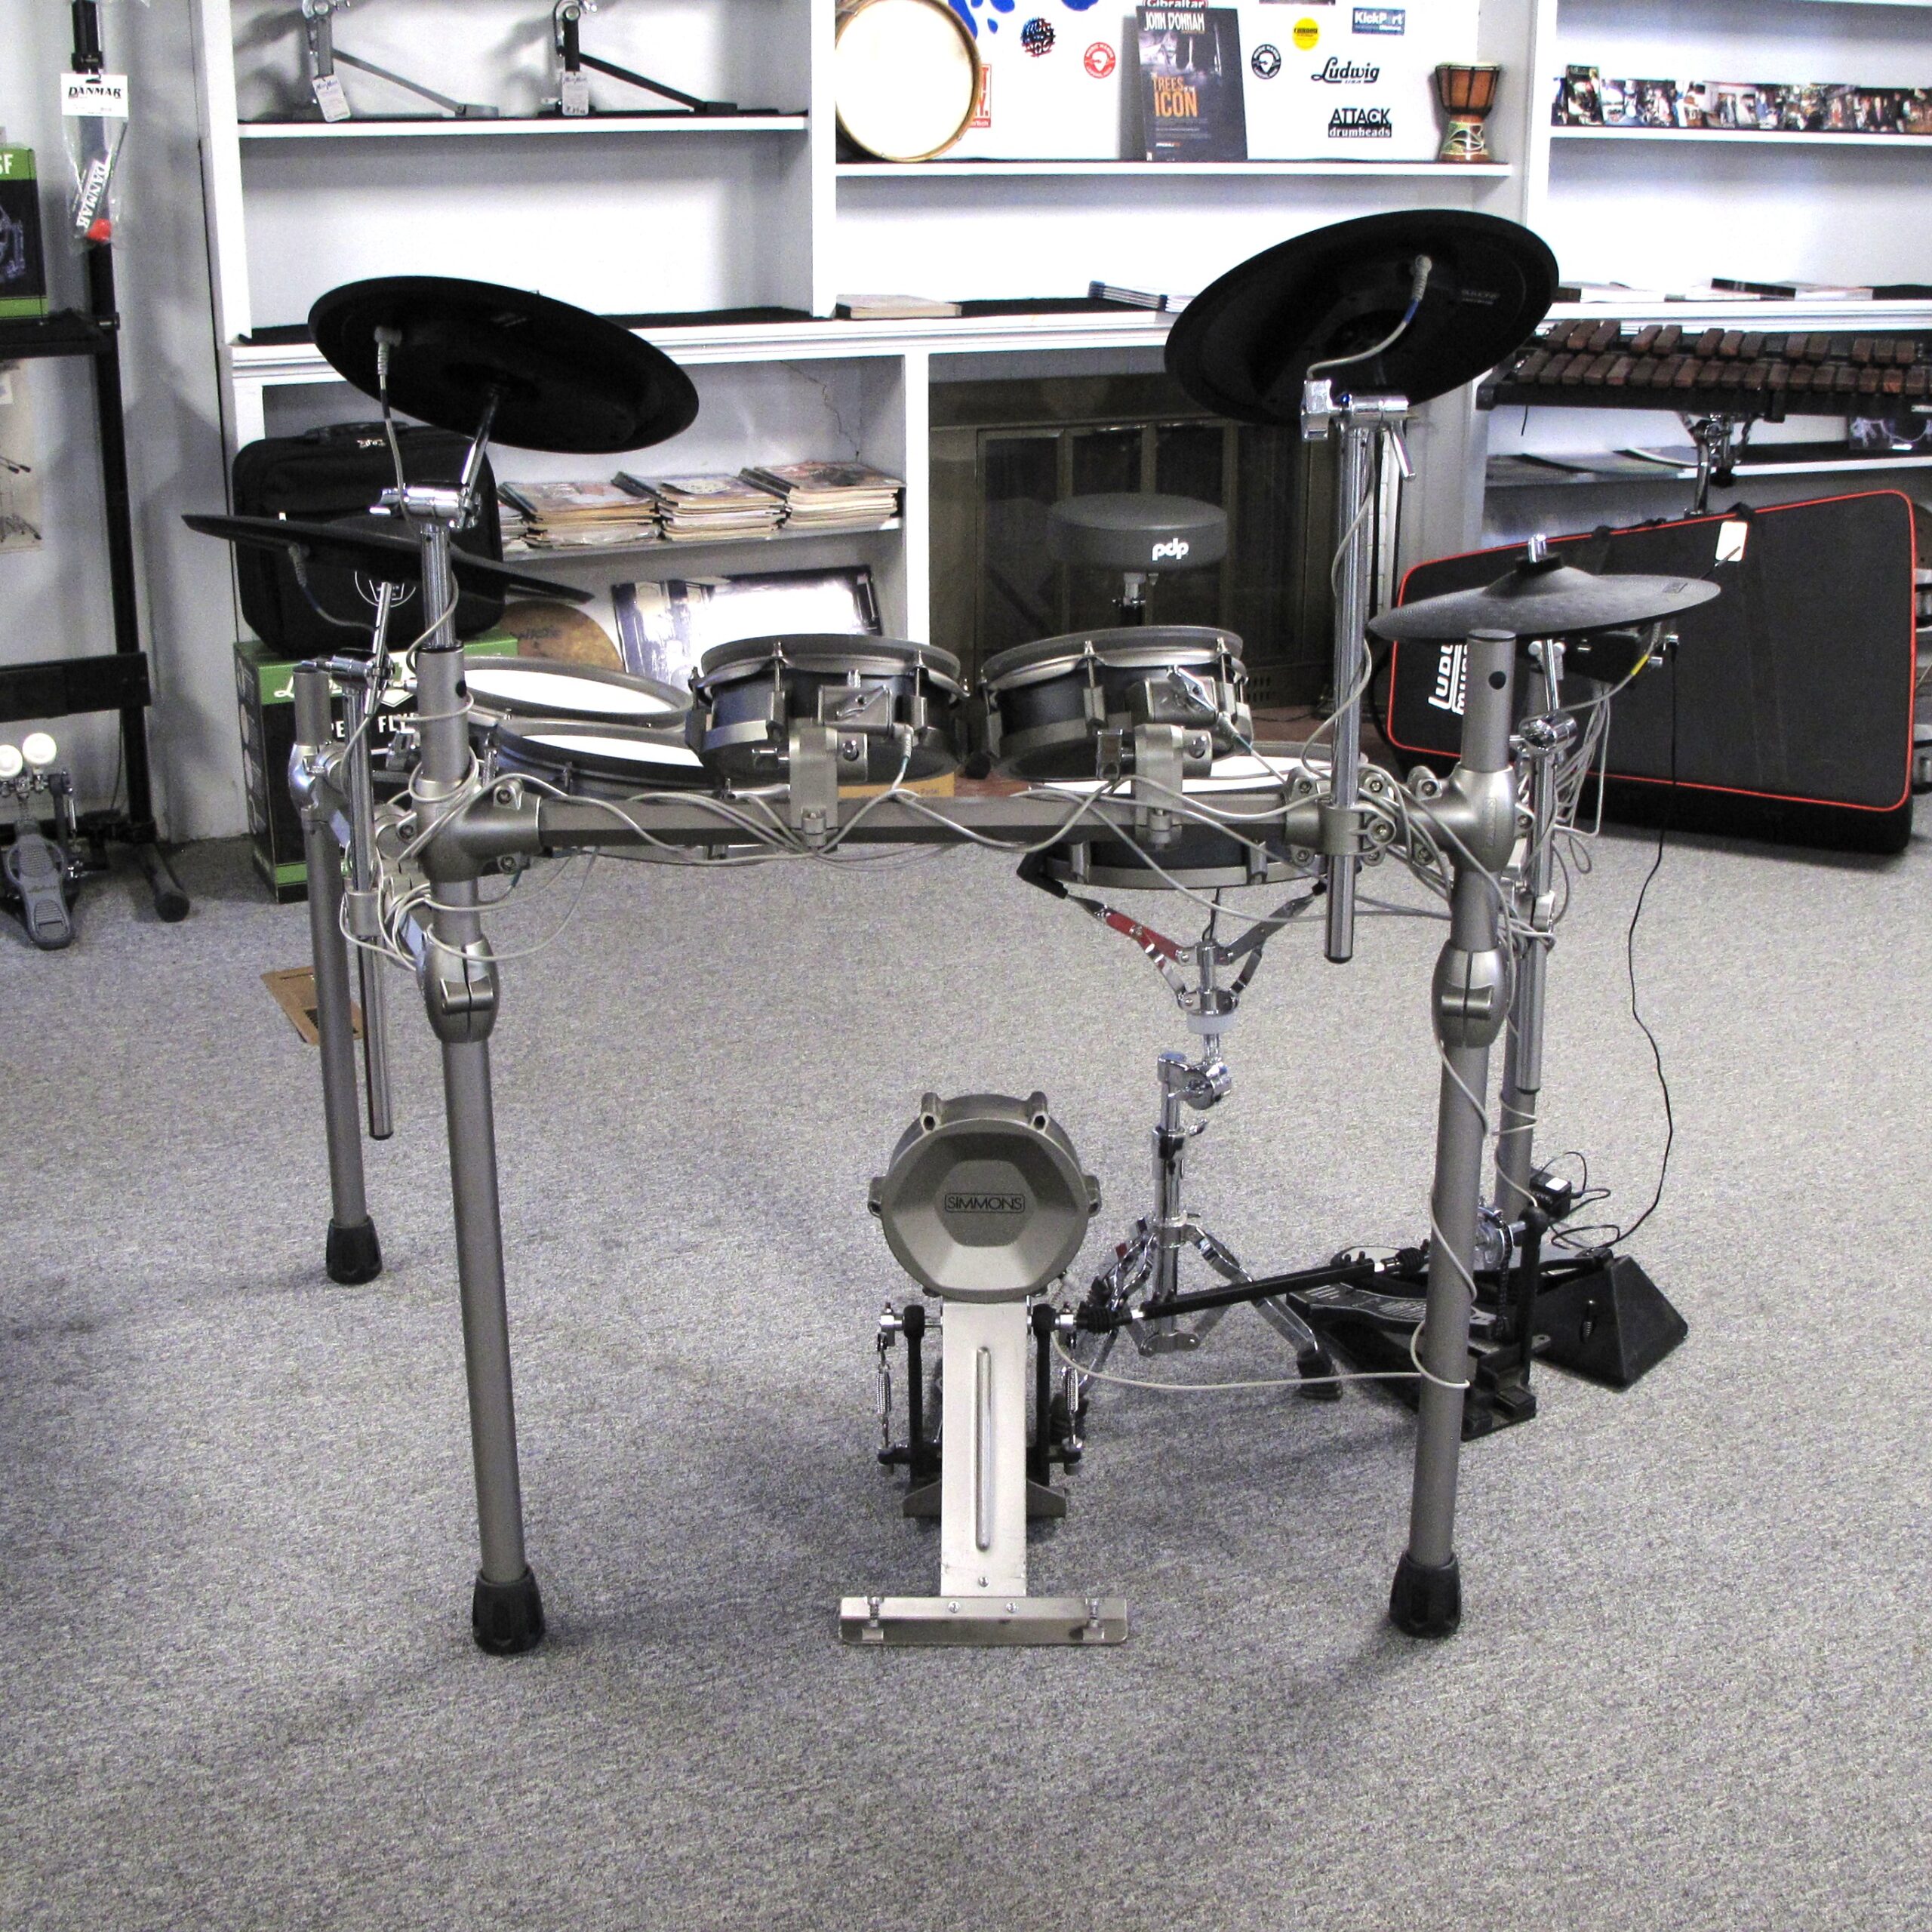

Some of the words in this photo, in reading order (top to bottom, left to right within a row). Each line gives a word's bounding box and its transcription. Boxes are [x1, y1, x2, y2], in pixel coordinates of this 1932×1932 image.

[1311, 57, 1380, 84] Ludwig
[69, 86, 122, 98] DANMAR
[1155, 91, 1198, 117] ICON
[1331, 108, 1391, 124] ATTACK
[1329, 127, 1391, 137] drumheads
[76, 162, 106, 228] DANMAR
[1152, 537, 1189, 561] pdp
[948, 1196, 1023, 1210] SIMMONS
